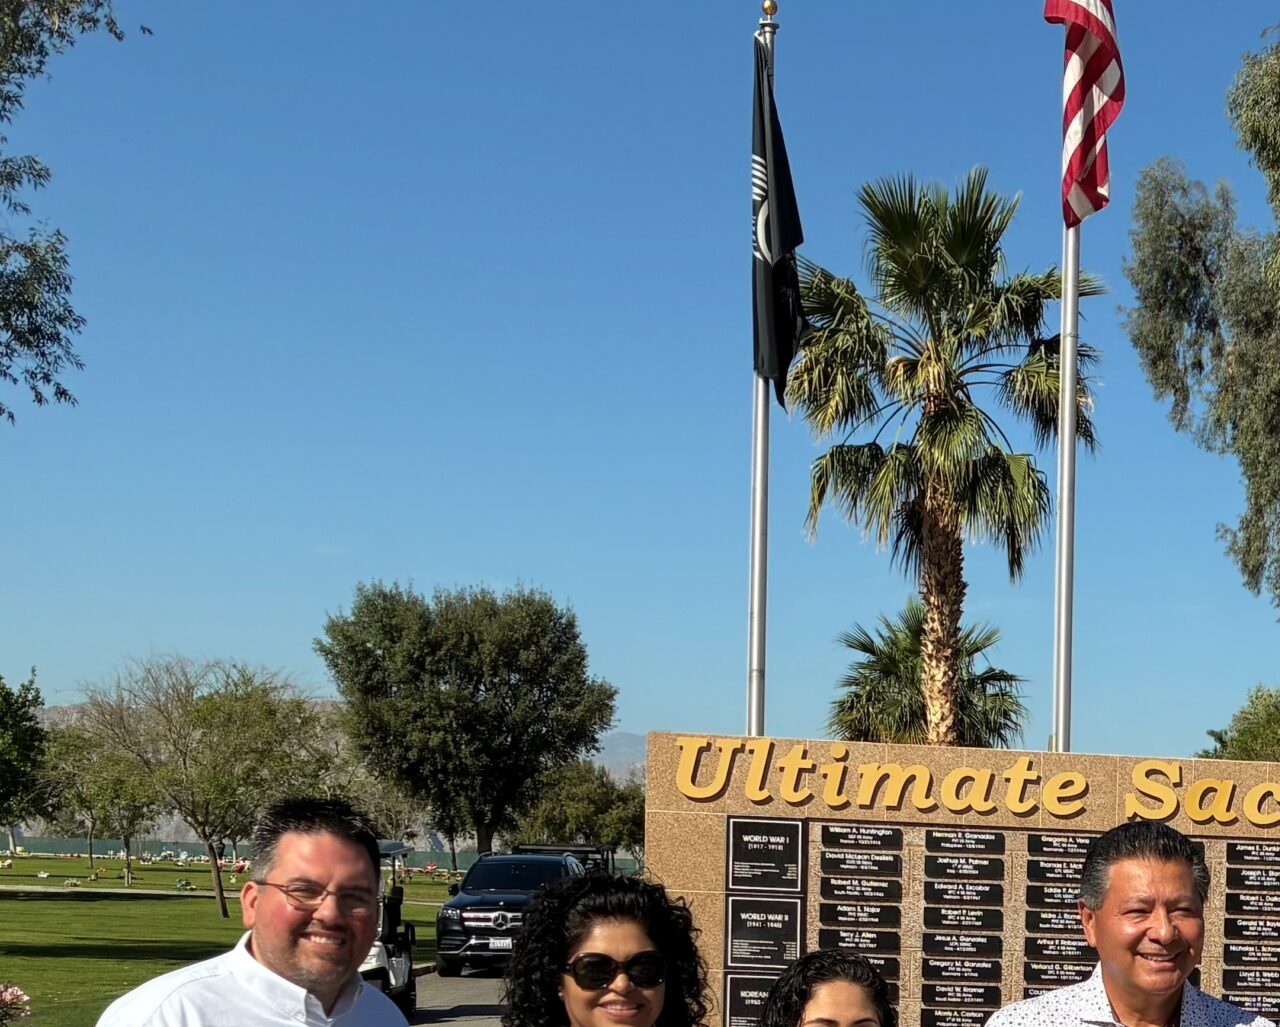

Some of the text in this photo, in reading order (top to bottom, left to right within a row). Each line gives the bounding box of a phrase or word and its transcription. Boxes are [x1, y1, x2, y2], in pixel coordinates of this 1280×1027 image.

[675, 736, 1088, 815] Ultimate
[829, 826, 850, 834] William
[860, 828, 892, 836] Huntington
[742, 835, 768, 843] WORLD
[740, 913, 766, 921] WORLD
[767, 913, 784, 921] WAR
